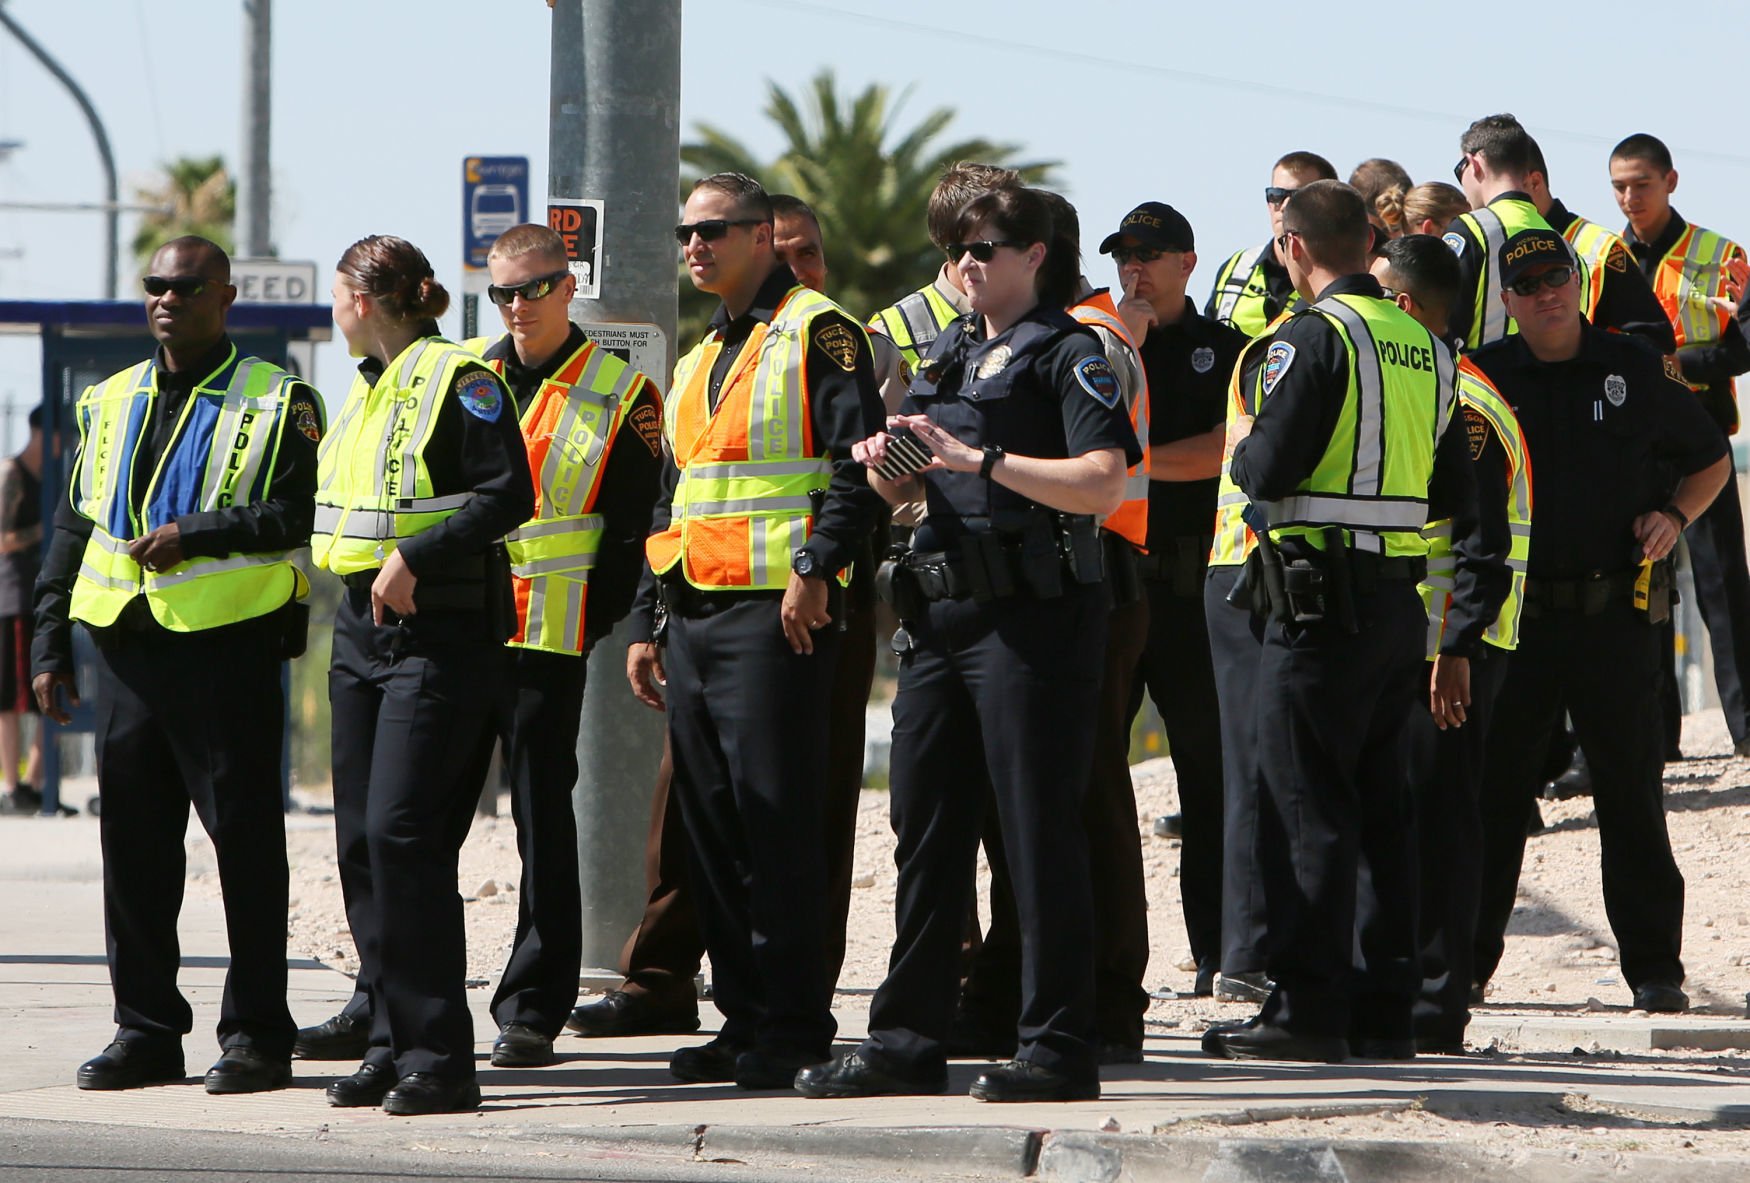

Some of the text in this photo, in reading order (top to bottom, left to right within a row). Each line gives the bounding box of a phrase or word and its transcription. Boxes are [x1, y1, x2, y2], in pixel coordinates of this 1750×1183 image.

[549, 208, 582, 232] RD
[1505, 240, 1557, 267] POLICE
[584, 329, 649, 339] EDESTRIANS MUST
[602, 340, 631, 348] BUTTON
[633, 340, 648, 348] FOR
[1378, 339, 1433, 373] POLICE
[767, 338, 785, 455] POLICE
[217, 412, 255, 510] POLIC
